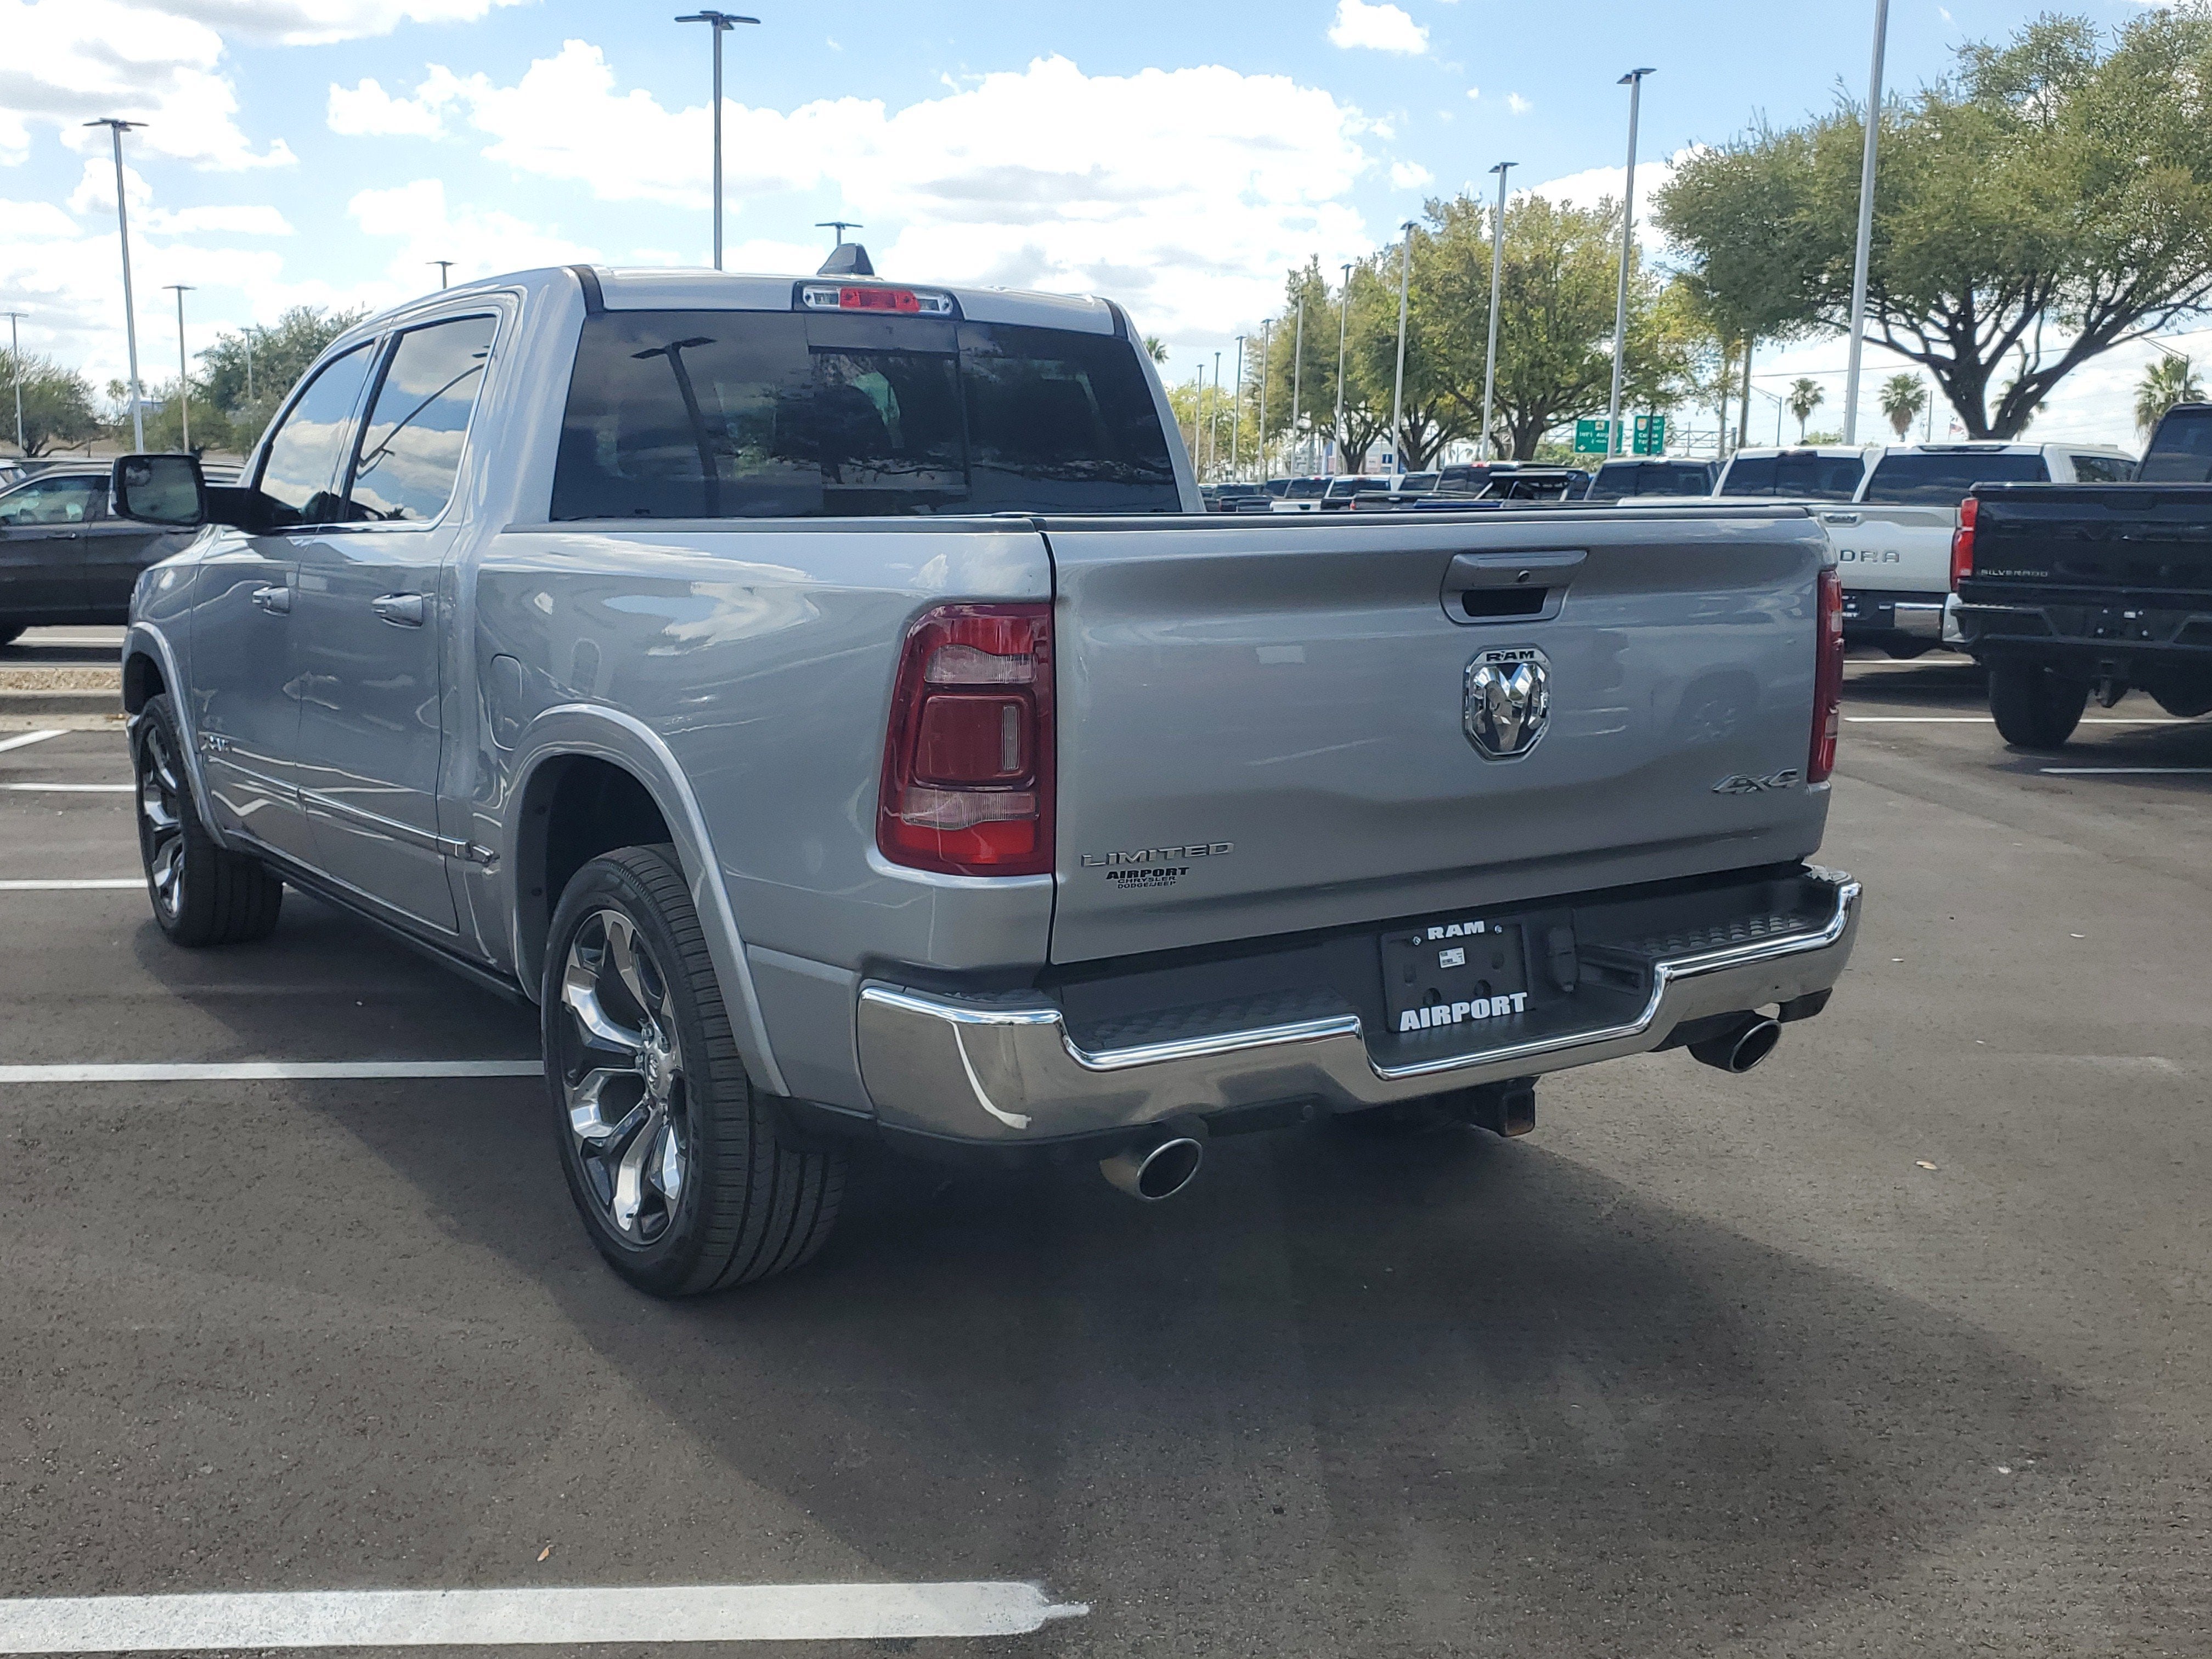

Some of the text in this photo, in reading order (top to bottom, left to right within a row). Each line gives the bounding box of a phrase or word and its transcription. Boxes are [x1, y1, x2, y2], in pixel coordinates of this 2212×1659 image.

[1839, 550, 1900, 563] DRA
[1486, 650, 1534, 662] RAM
[1081, 840, 1234, 867] LIMITED
[1106, 867, 1190, 880] AIRPORT
[1117, 876, 1177, 884] CHRYSLER
[1427, 921, 1485, 940] RAM
[1400, 992, 1528, 1032] AIRPORT
